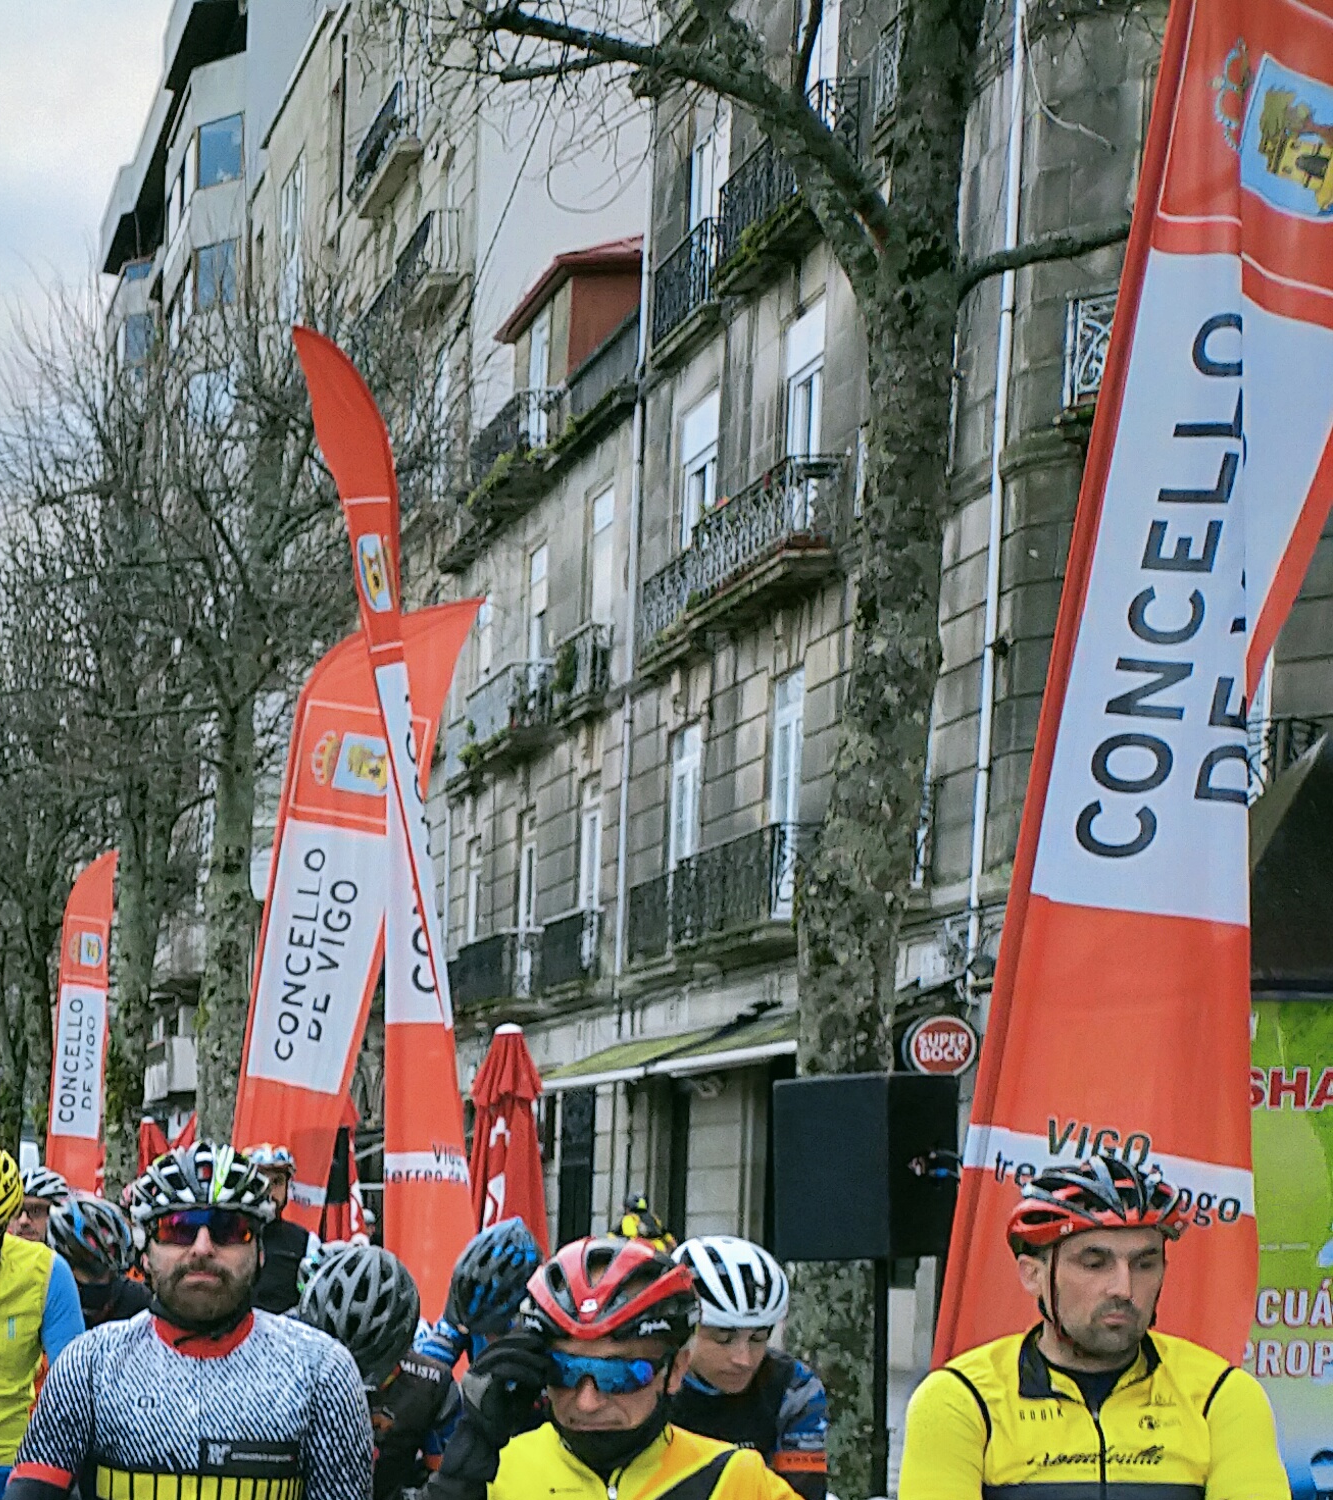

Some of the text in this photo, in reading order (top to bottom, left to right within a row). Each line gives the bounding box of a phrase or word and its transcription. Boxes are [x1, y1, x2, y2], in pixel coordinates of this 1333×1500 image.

[1075, 313, 1244, 858] CONCELLO
[275, 847, 327, 1061] CONCELLO
[315, 879, 358, 973] VIGO
[59, 998, 84, 1123] CONCELLO
[84, 1015, 96, 1072] VIGO
[918, 1032, 968, 1049] SUPER
[920, 1046, 966, 1063] BOCK
